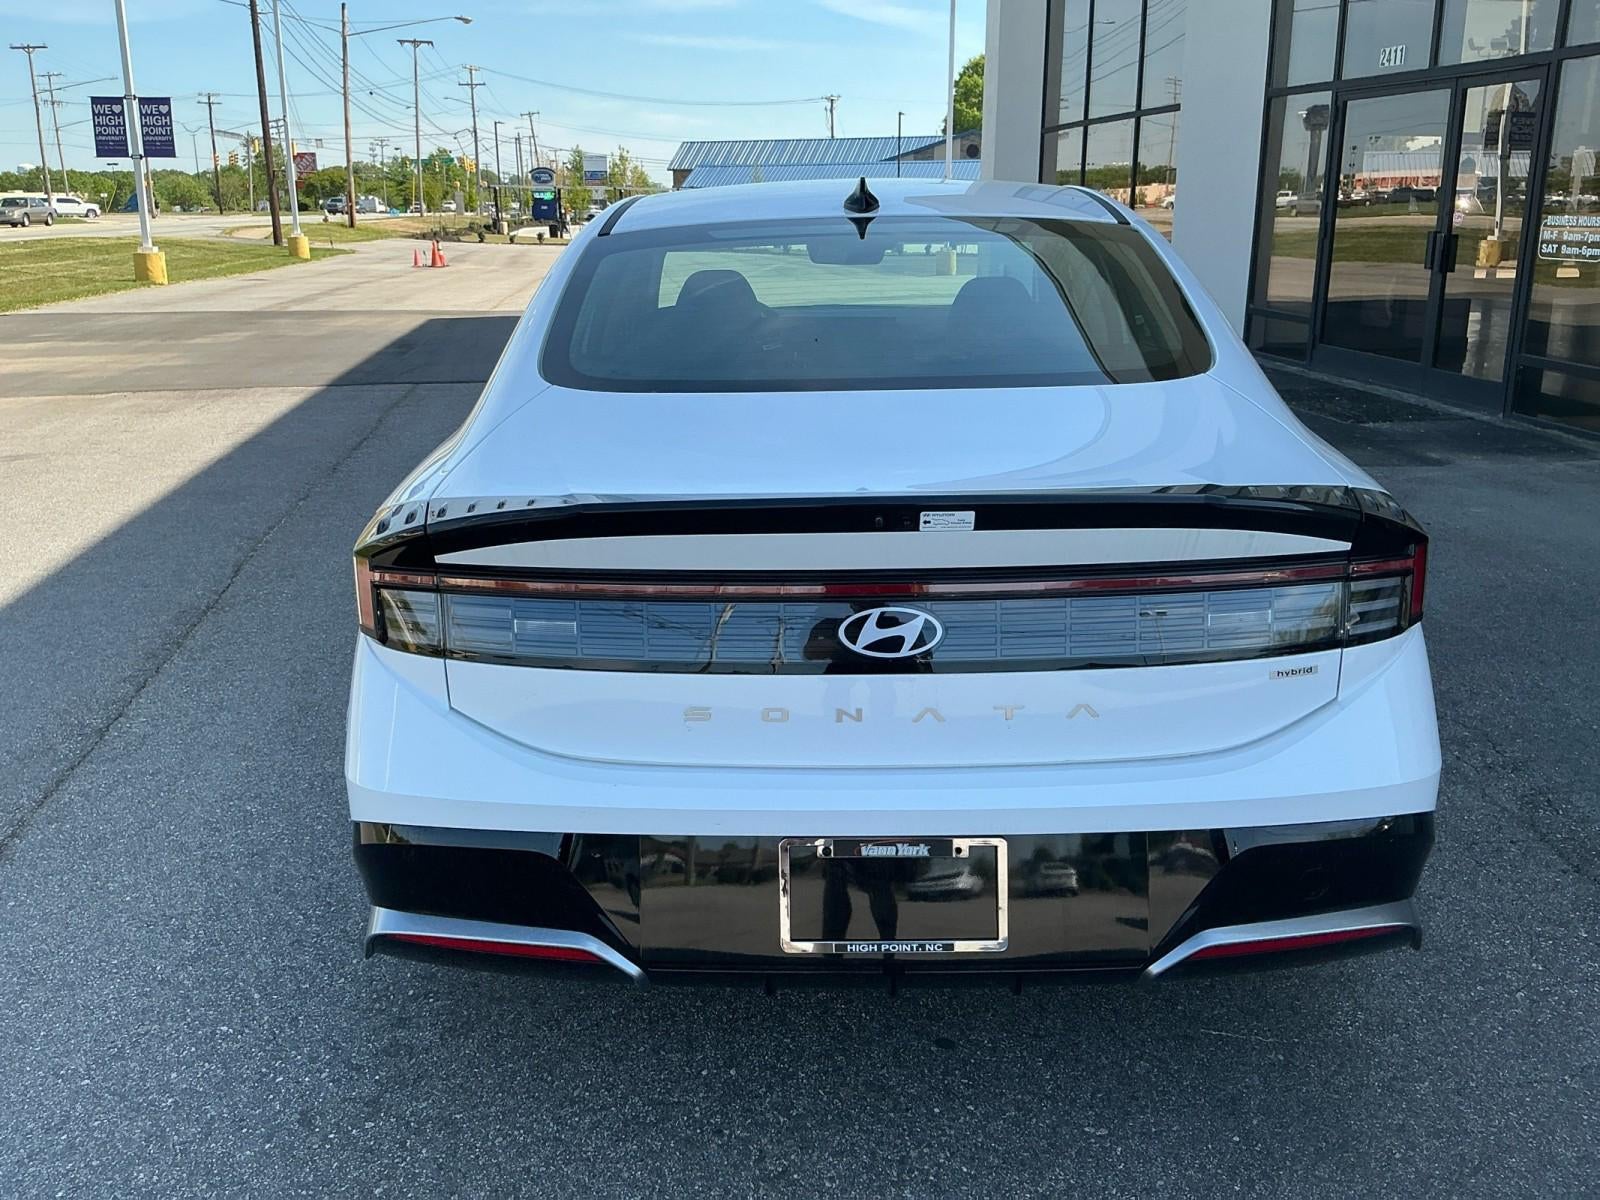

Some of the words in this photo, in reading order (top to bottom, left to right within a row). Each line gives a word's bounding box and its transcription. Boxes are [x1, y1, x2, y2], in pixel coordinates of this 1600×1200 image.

[1380, 46, 1404, 66] 2411
[93, 104, 112, 114] WE
[140, 104, 159, 114] WE
[94, 115, 123, 125] HIGH
[142, 116, 170, 126] HIGH
[95, 126, 125, 135] POINT
[143, 126, 171, 135] POINT
[1547, 215, 1577, 226] BUSINESS
[1578, 215, 1600, 227] HOURS
[1543, 230, 1558, 240] M-F
[1563, 231, 1600, 243] 9am-7pm
[1541, 243, 1558, 253] SAT
[1561, 244, 1600, 257] 9am-6pm
[1277, 666, 1313, 678] hybrid
[682, 703, 1100, 723] SONATA
[847, 944, 877, 952] HIGH
[925, 943, 943, 952] NC
